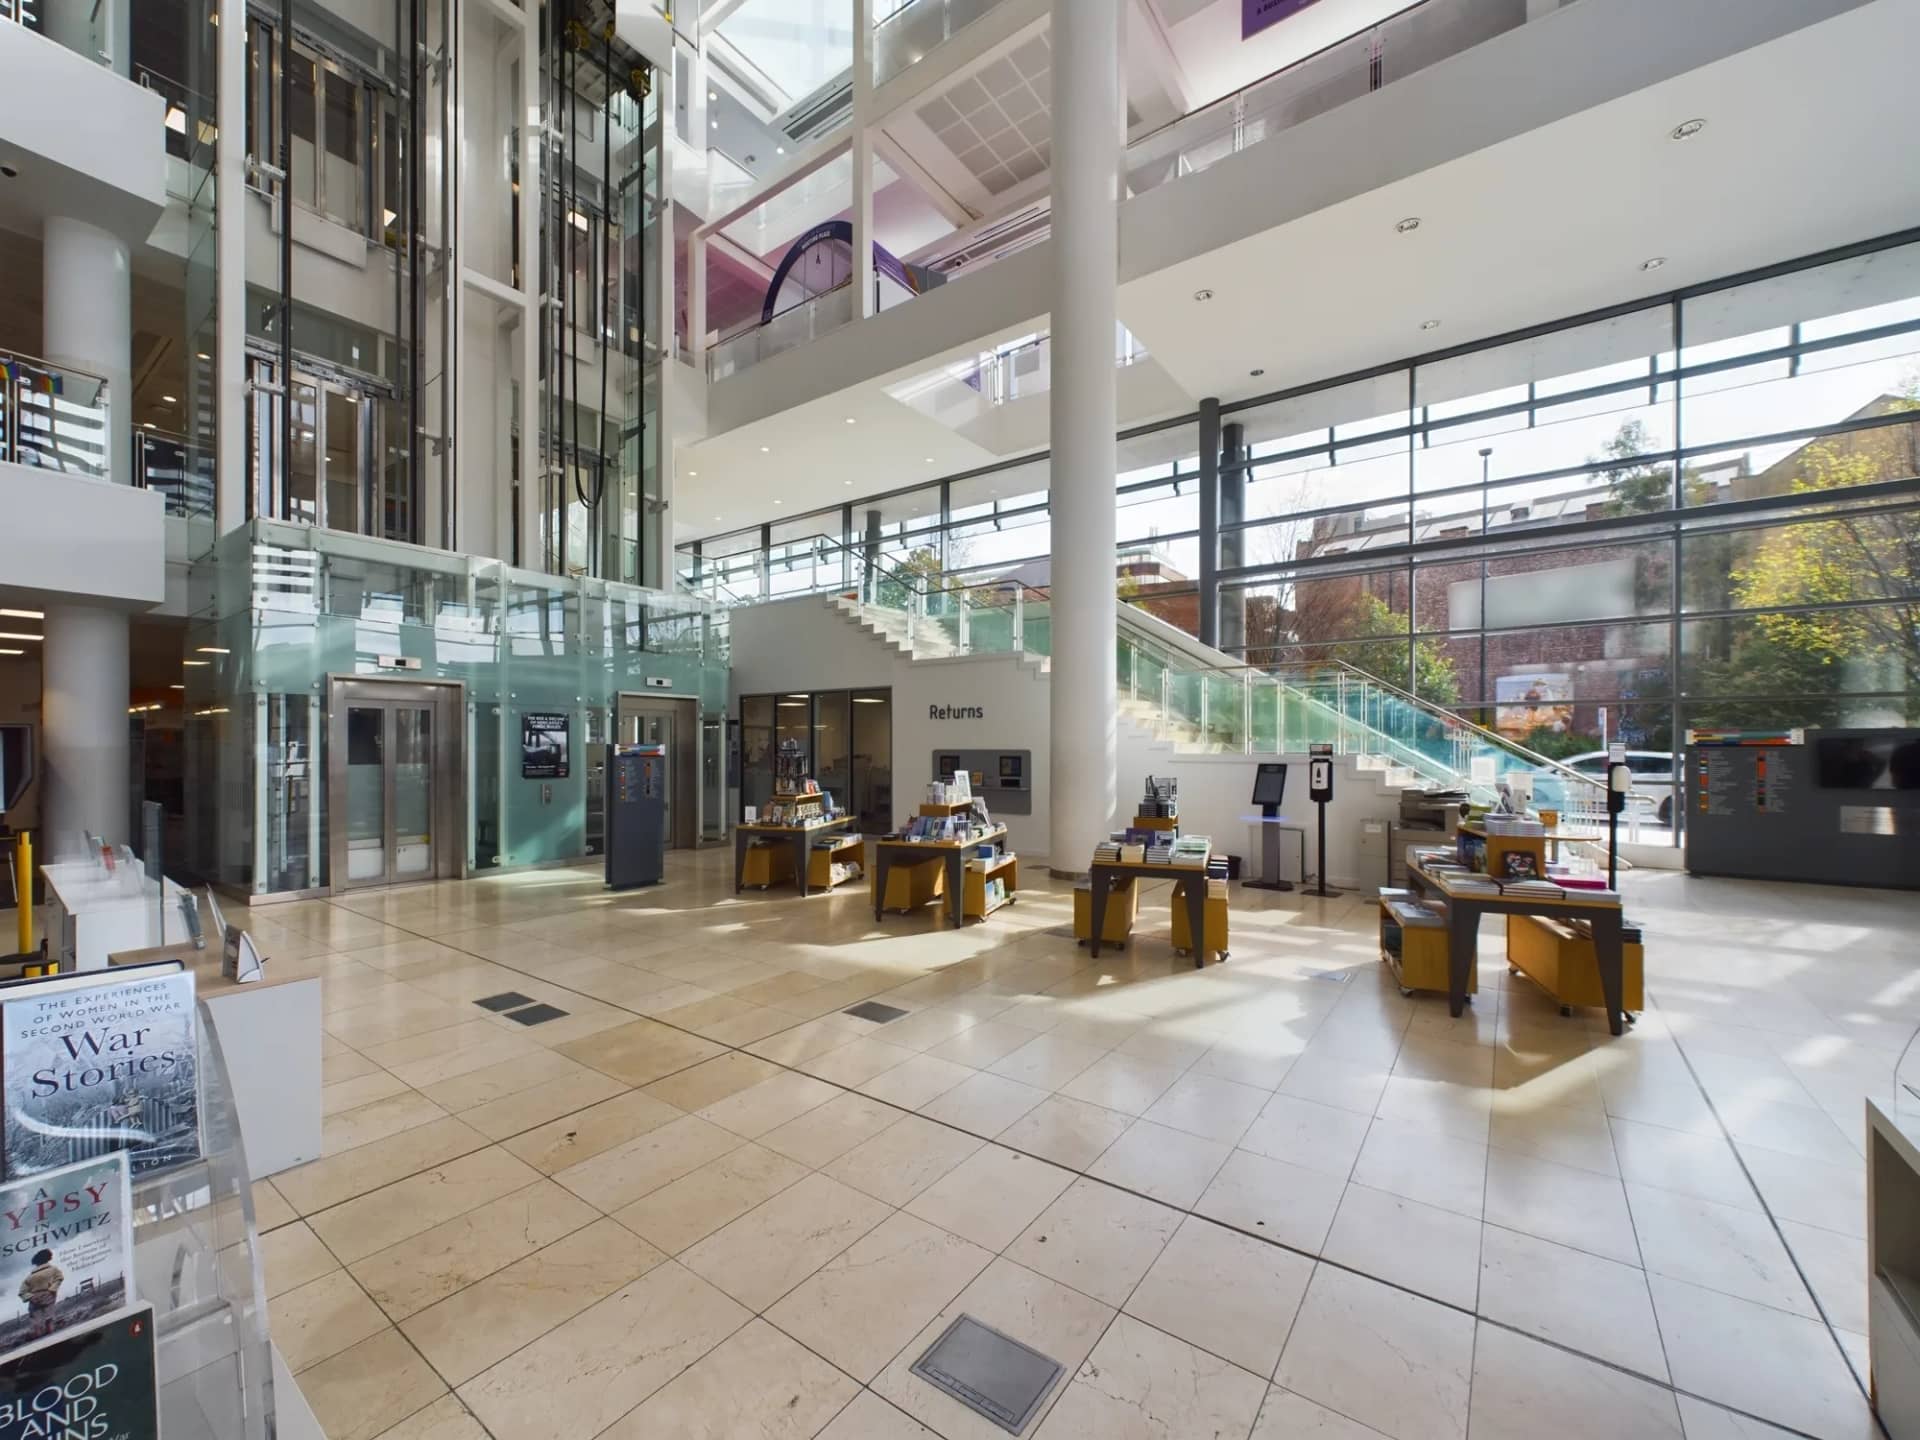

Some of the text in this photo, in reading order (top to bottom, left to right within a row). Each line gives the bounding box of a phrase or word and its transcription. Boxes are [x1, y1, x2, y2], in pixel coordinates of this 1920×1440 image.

[929, 703, 984, 720] Returns
[33, 993, 171, 1025] OF WOMEN IN THE
[37, 982, 167, 1012] THE EXPERIENCES
[21, 1002, 181, 1039] SECOND WORLD WAR
[59, 1026, 151, 1061] War
[32, 1050, 176, 1099] Stories
[132, 1155, 172, 1172] LTON
[3, 1182, 108, 1231] YPSY
[33, 1187, 49, 1202] A
[2, 1211, 112, 1257] SCHWITZ
[34, 1221, 51, 1233] IN
[0, 1363, 118, 1429] BLOOD
[20, 1396, 97, 1440] AND
